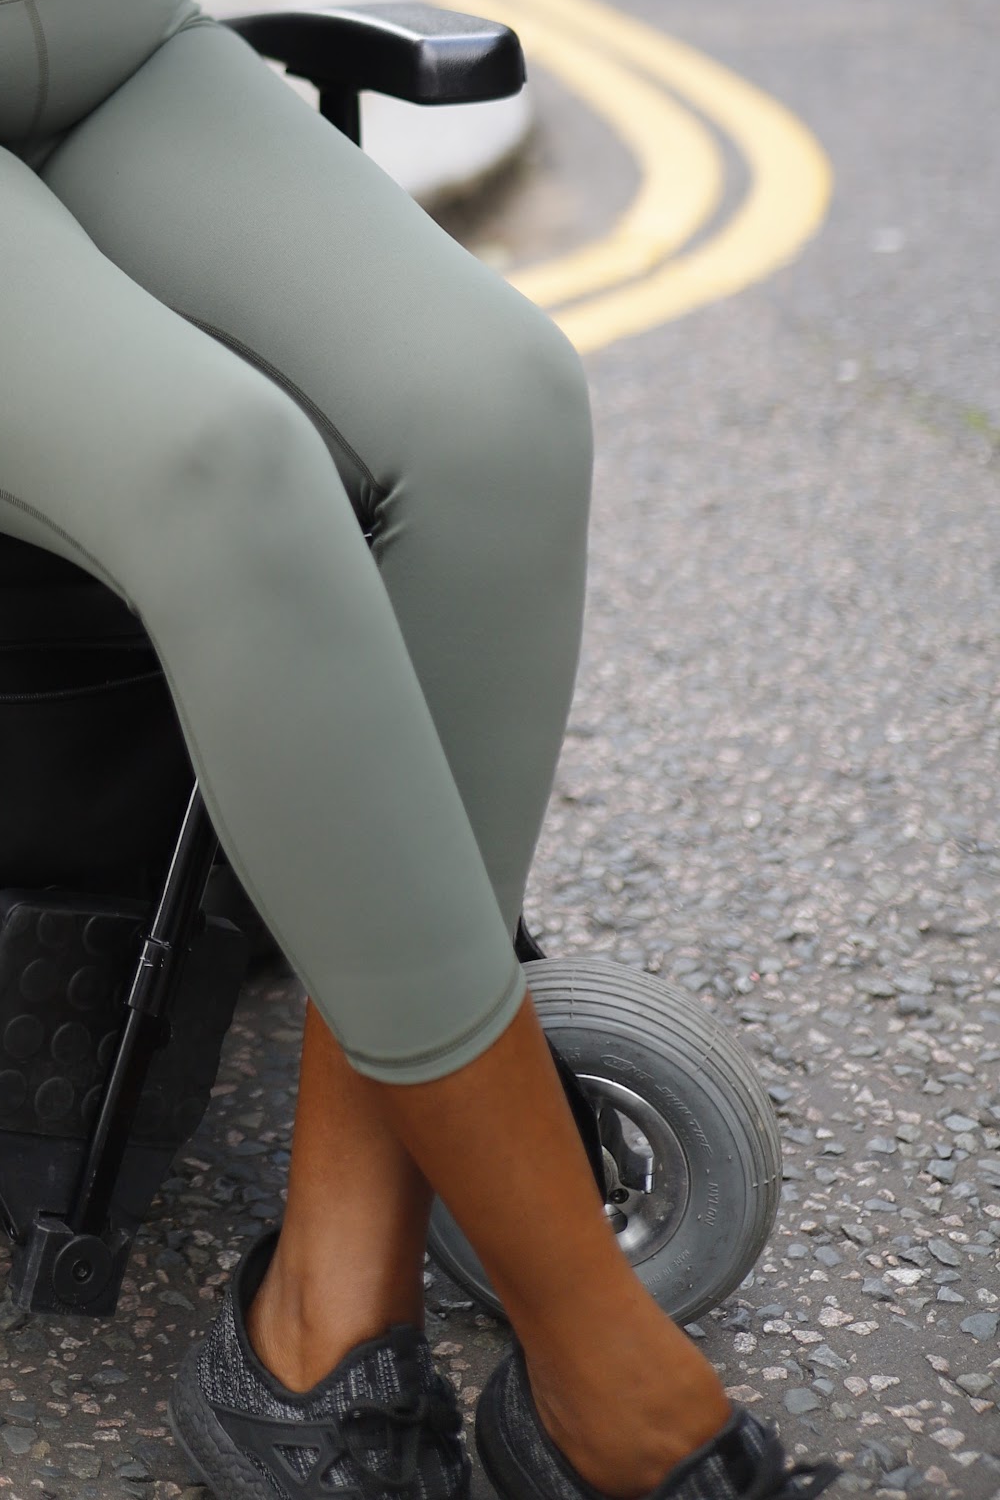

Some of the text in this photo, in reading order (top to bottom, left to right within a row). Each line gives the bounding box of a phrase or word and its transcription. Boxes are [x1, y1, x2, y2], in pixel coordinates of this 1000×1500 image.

[656, 1084, 693, 1116] SHIN
[689, 1118, 714, 1158] TIRE
[704, 1181, 720, 1227] NYLON
